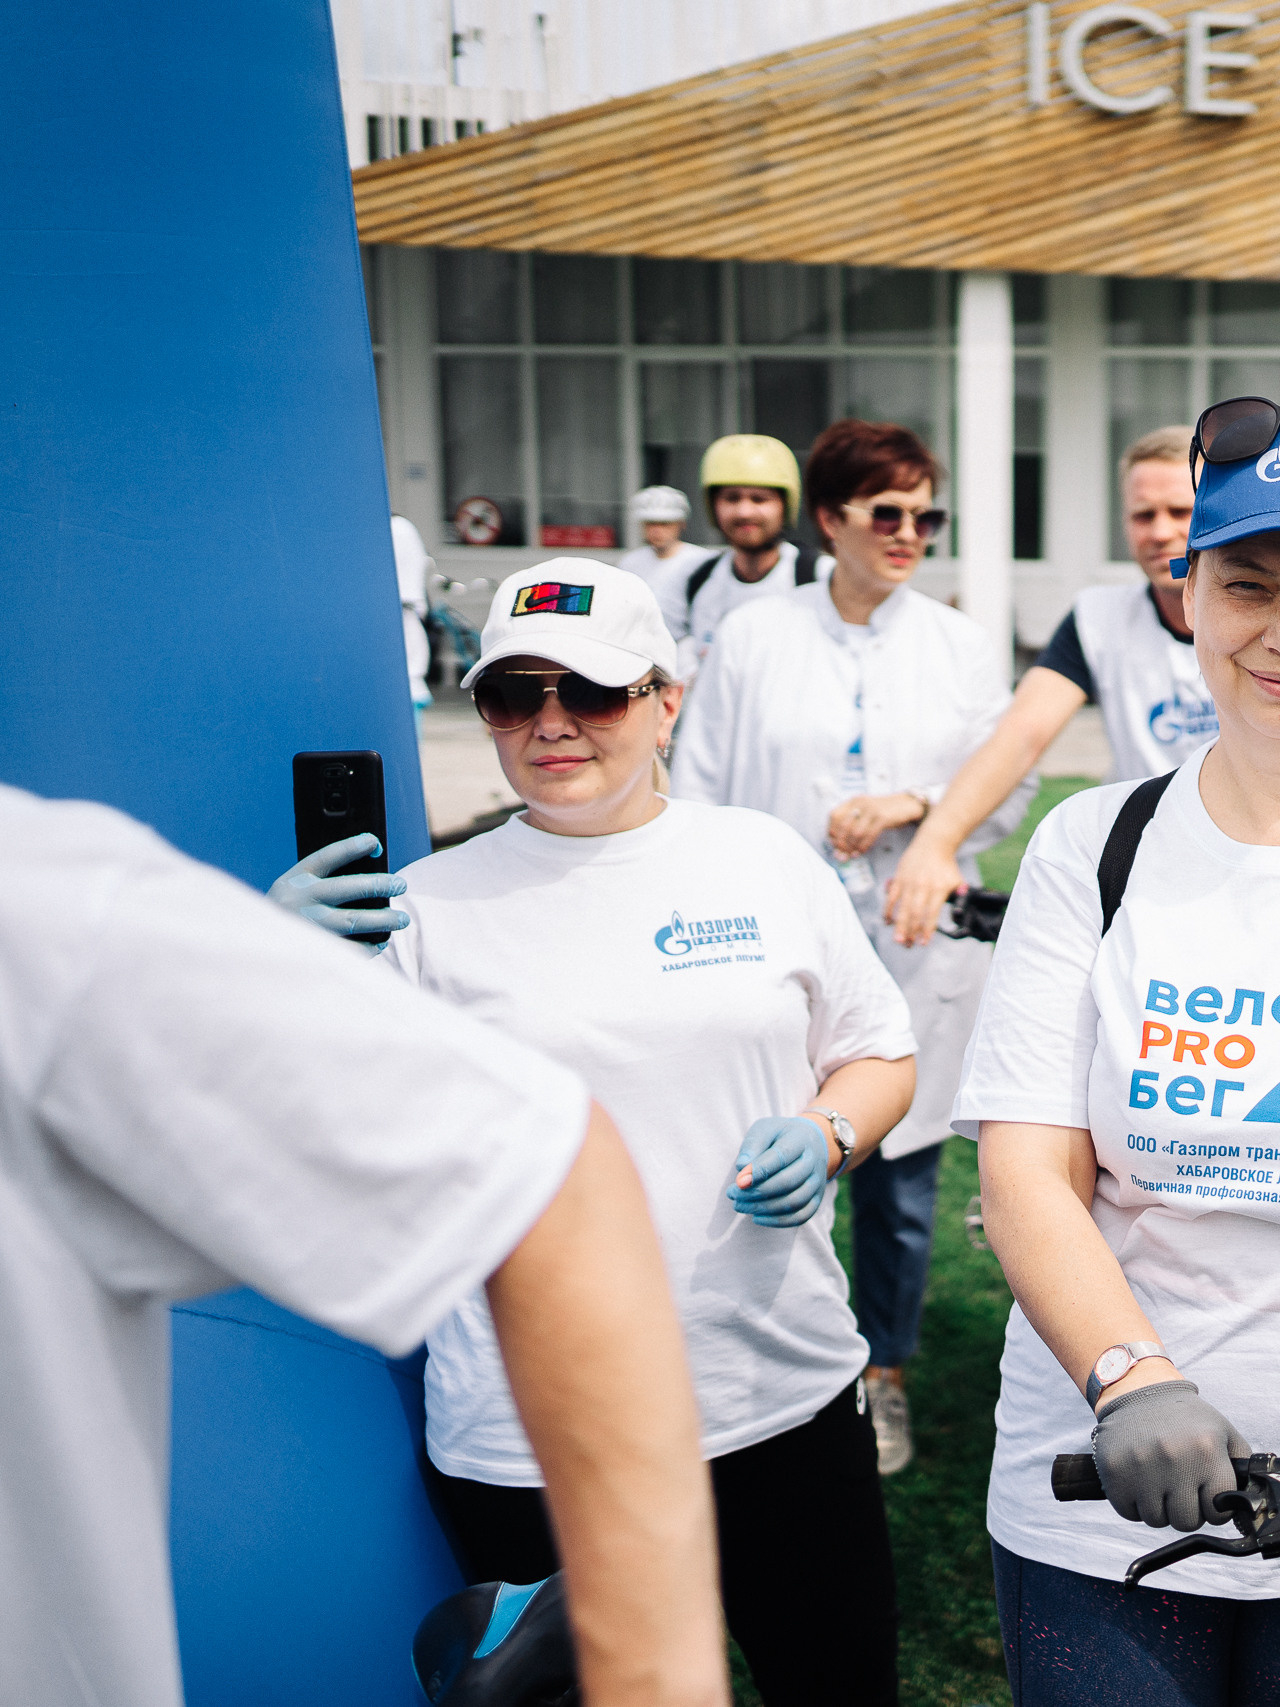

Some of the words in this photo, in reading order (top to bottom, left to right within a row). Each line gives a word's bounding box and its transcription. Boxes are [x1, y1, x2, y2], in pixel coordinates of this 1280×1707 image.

[1027, 2, 1258, 117] ICE
[688, 916, 759, 936] ГАЗПРОМ
[661, 956, 733, 972] ХАБАРОВСКОЕ
[1139, 1020, 1256, 1069] PRO
[1127, 1133, 1157, 1153] ООО
[1161, 1140, 1241, 1159] «Газпром
[1130, 1173, 1192, 1195] Первичная
[1176, 1164, 1273, 1184] ХАБАРОВСКОЕ
